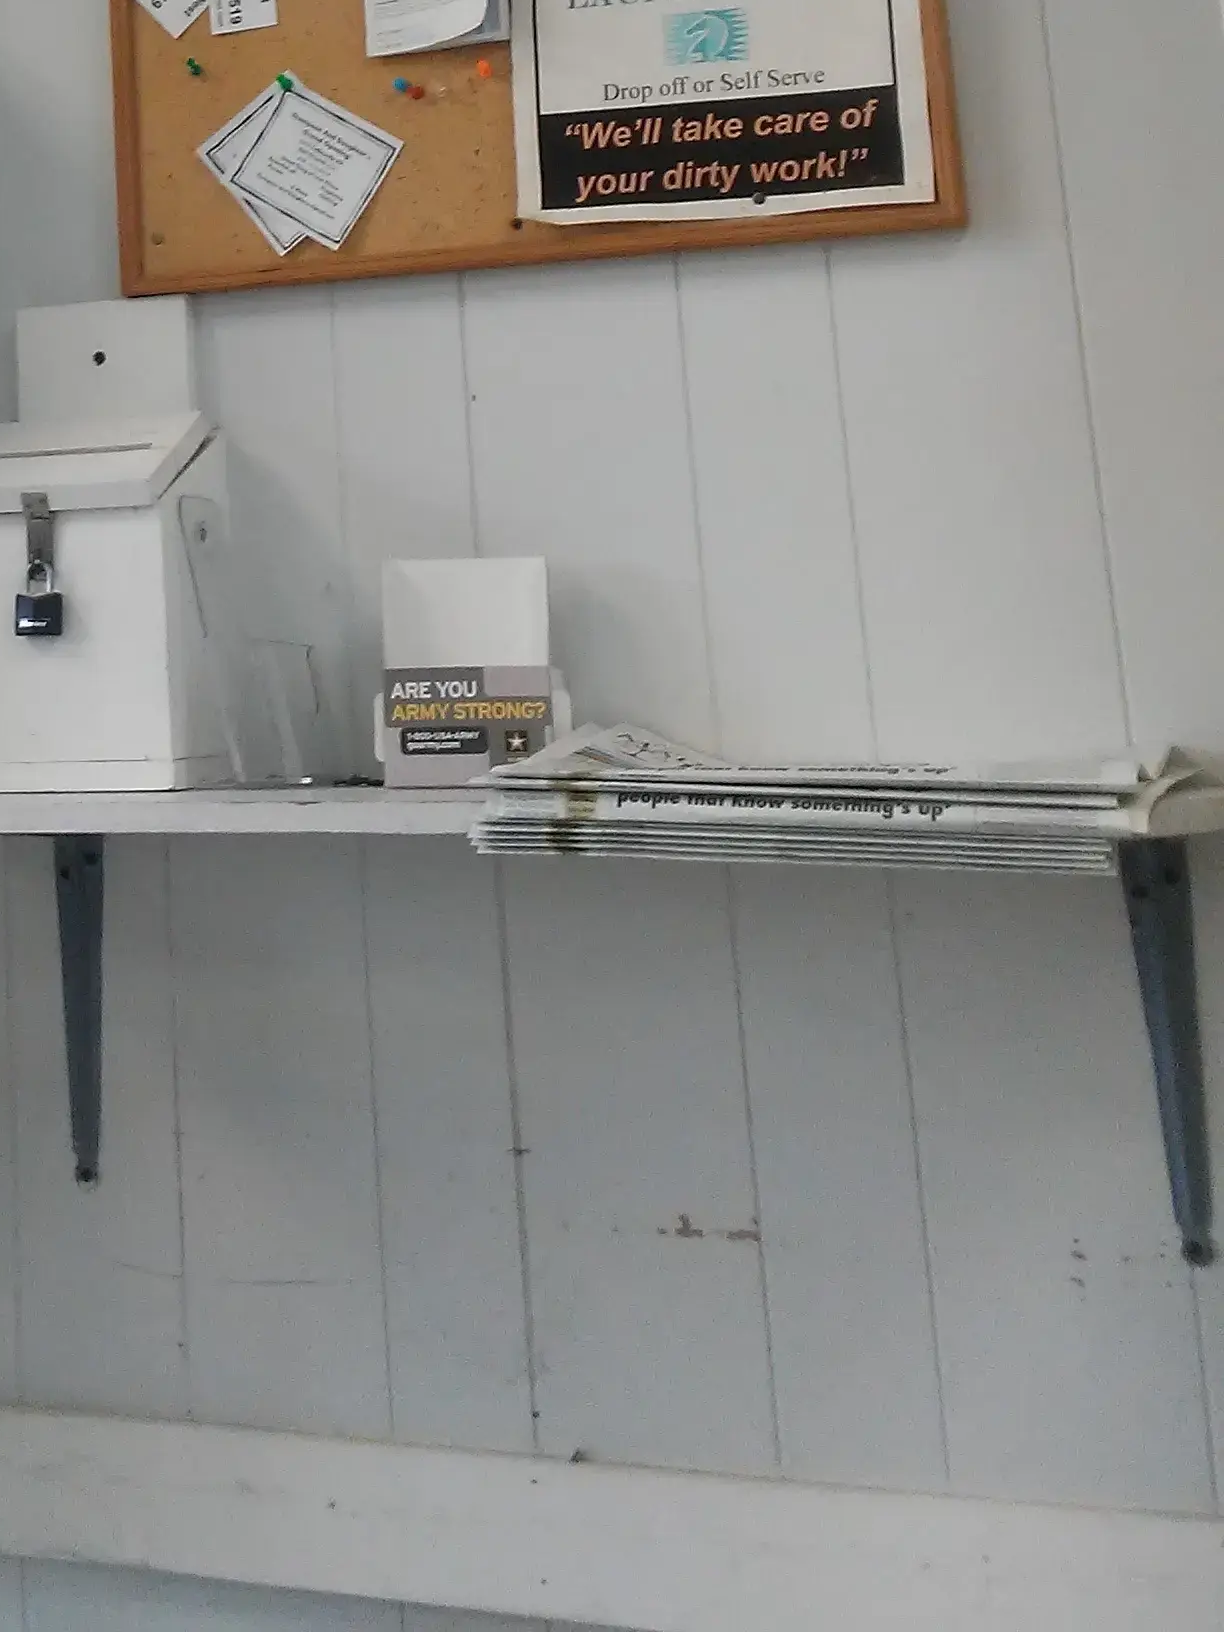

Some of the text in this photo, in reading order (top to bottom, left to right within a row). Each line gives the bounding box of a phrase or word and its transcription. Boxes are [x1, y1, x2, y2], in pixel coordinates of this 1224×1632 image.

[603, 68, 826, 103] Drop off or Self Serve
[672, 113, 744, 143] take
[753, 108, 828, 136] care
[840, 99, 879, 129] of
[575, 168, 653, 203] your
[662, 161, 741, 194] dirty
[390, 680, 477, 699] ARE YOU
[391, 701, 547, 721] ARMY STRONG?
